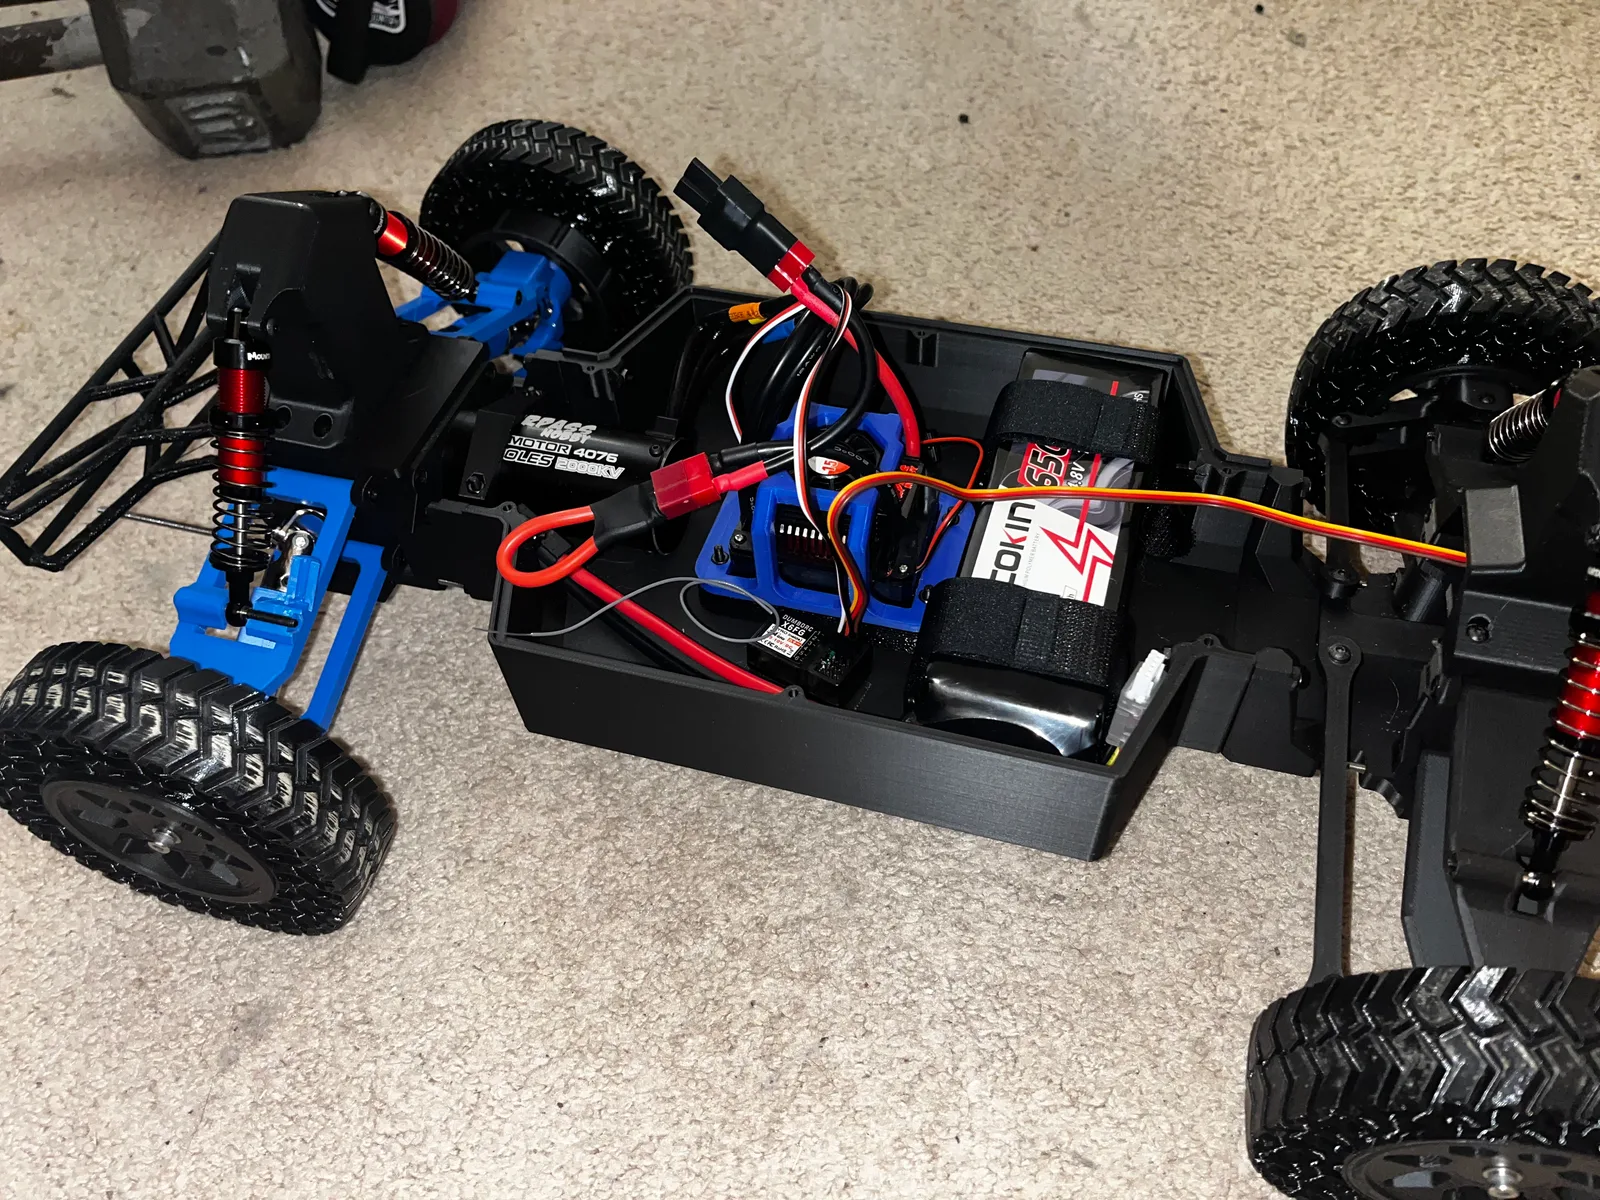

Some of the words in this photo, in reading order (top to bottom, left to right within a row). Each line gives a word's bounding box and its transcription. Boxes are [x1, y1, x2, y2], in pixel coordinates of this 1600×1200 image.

[540, 427, 592, 444] HOBBY
[507, 435, 572, 455] MOTOR
[573, 448, 619, 463] 4076
[554, 457, 625, 480] 2000KV
[781, 620, 806, 637] X6FG
